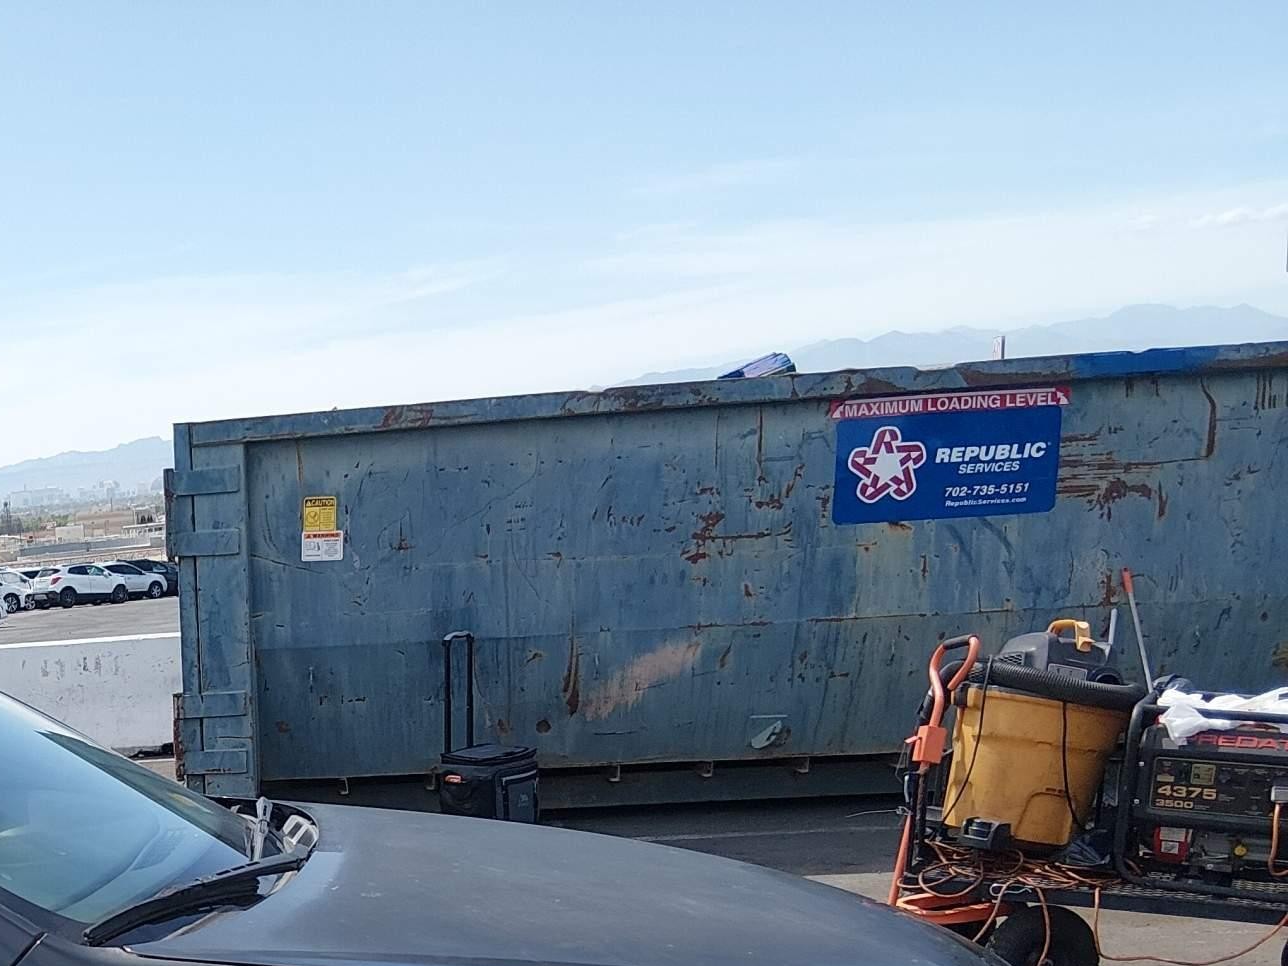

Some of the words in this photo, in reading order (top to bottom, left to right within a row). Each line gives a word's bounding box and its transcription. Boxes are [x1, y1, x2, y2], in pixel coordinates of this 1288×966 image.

[844, 399, 923, 417] MAXIMUM
[927, 395, 1001, 410] LOADING
[1005, 391, 1057, 407] LEVEL
[935, 441, 1047, 463] REPUBLIC
[958, 460, 1021, 475] SERVICES
[944, 482, 1030, 498] 702-735-5151
[311, 499, 335, 507] CAUTION
[1157, 784, 1217, 800] 4375
[1155, 798, 1194, 809] 3500
